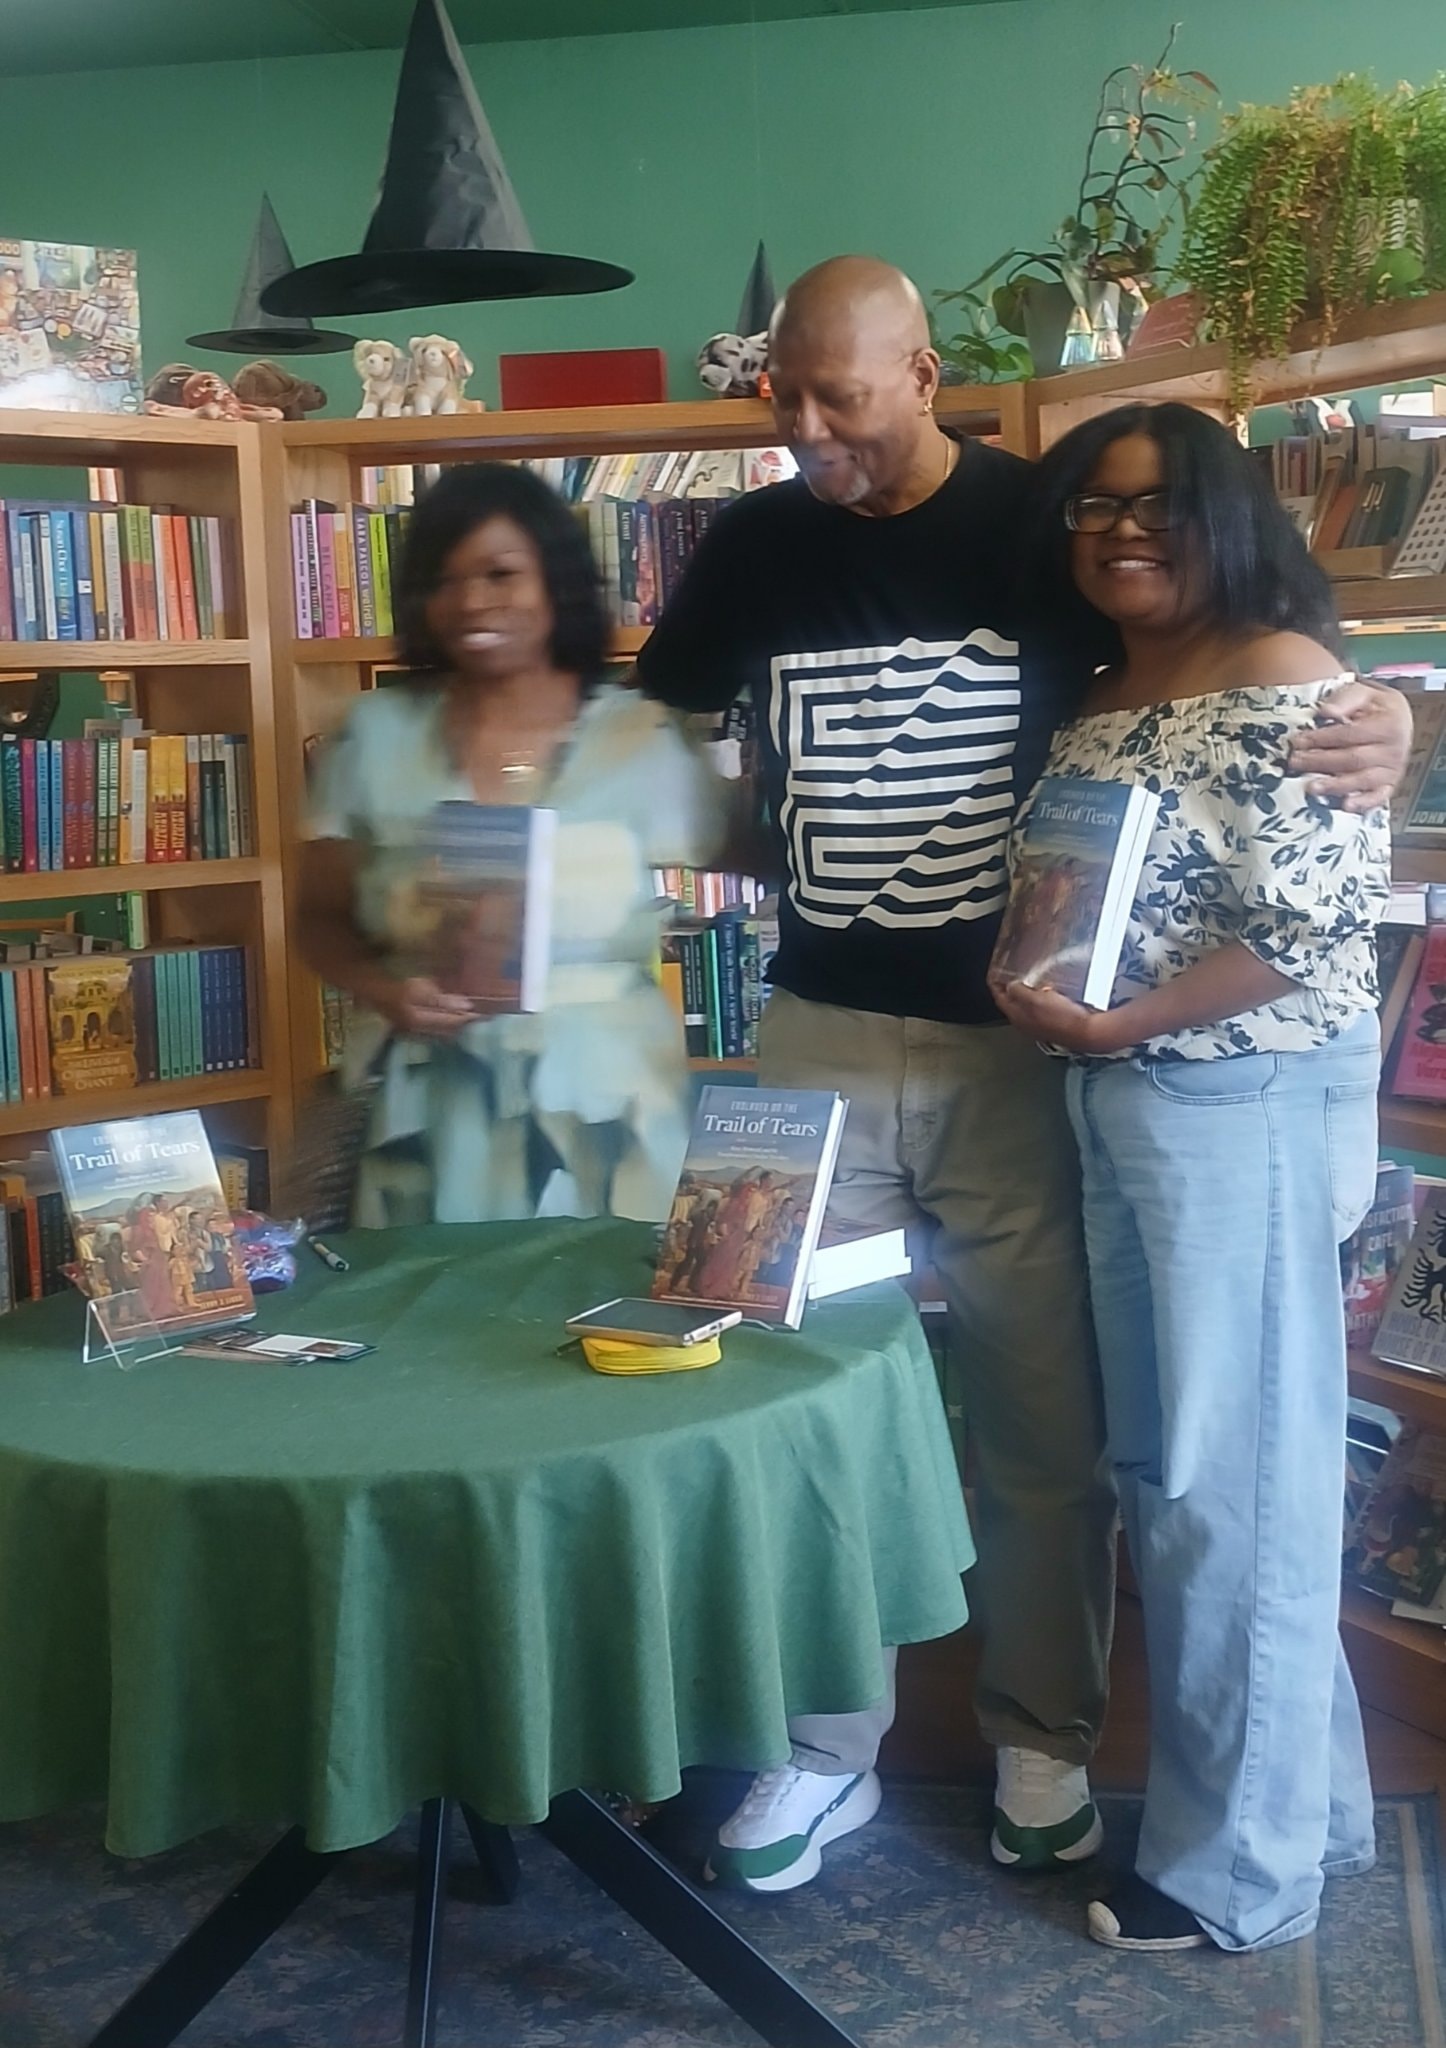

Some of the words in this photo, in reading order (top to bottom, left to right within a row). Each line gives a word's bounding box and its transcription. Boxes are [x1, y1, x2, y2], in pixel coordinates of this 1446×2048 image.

[322, 545, 331, 567] BEL
[359, 547, 370, 585] PASCOE
[324, 573, 335, 621] CANTO
[1039, 801, 1068, 820] Trail
[1067, 804, 1083, 822] of
[1084, 806, 1119, 827] Tears
[703, 1114, 746, 1134] Trail
[746, 1116, 770, 1134] of
[770, 1118, 819, 1137] Tears
[69, 1149, 120, 1171] Trail
[122, 1144, 143, 1163] of
[145, 1140, 201, 1159] Tears
